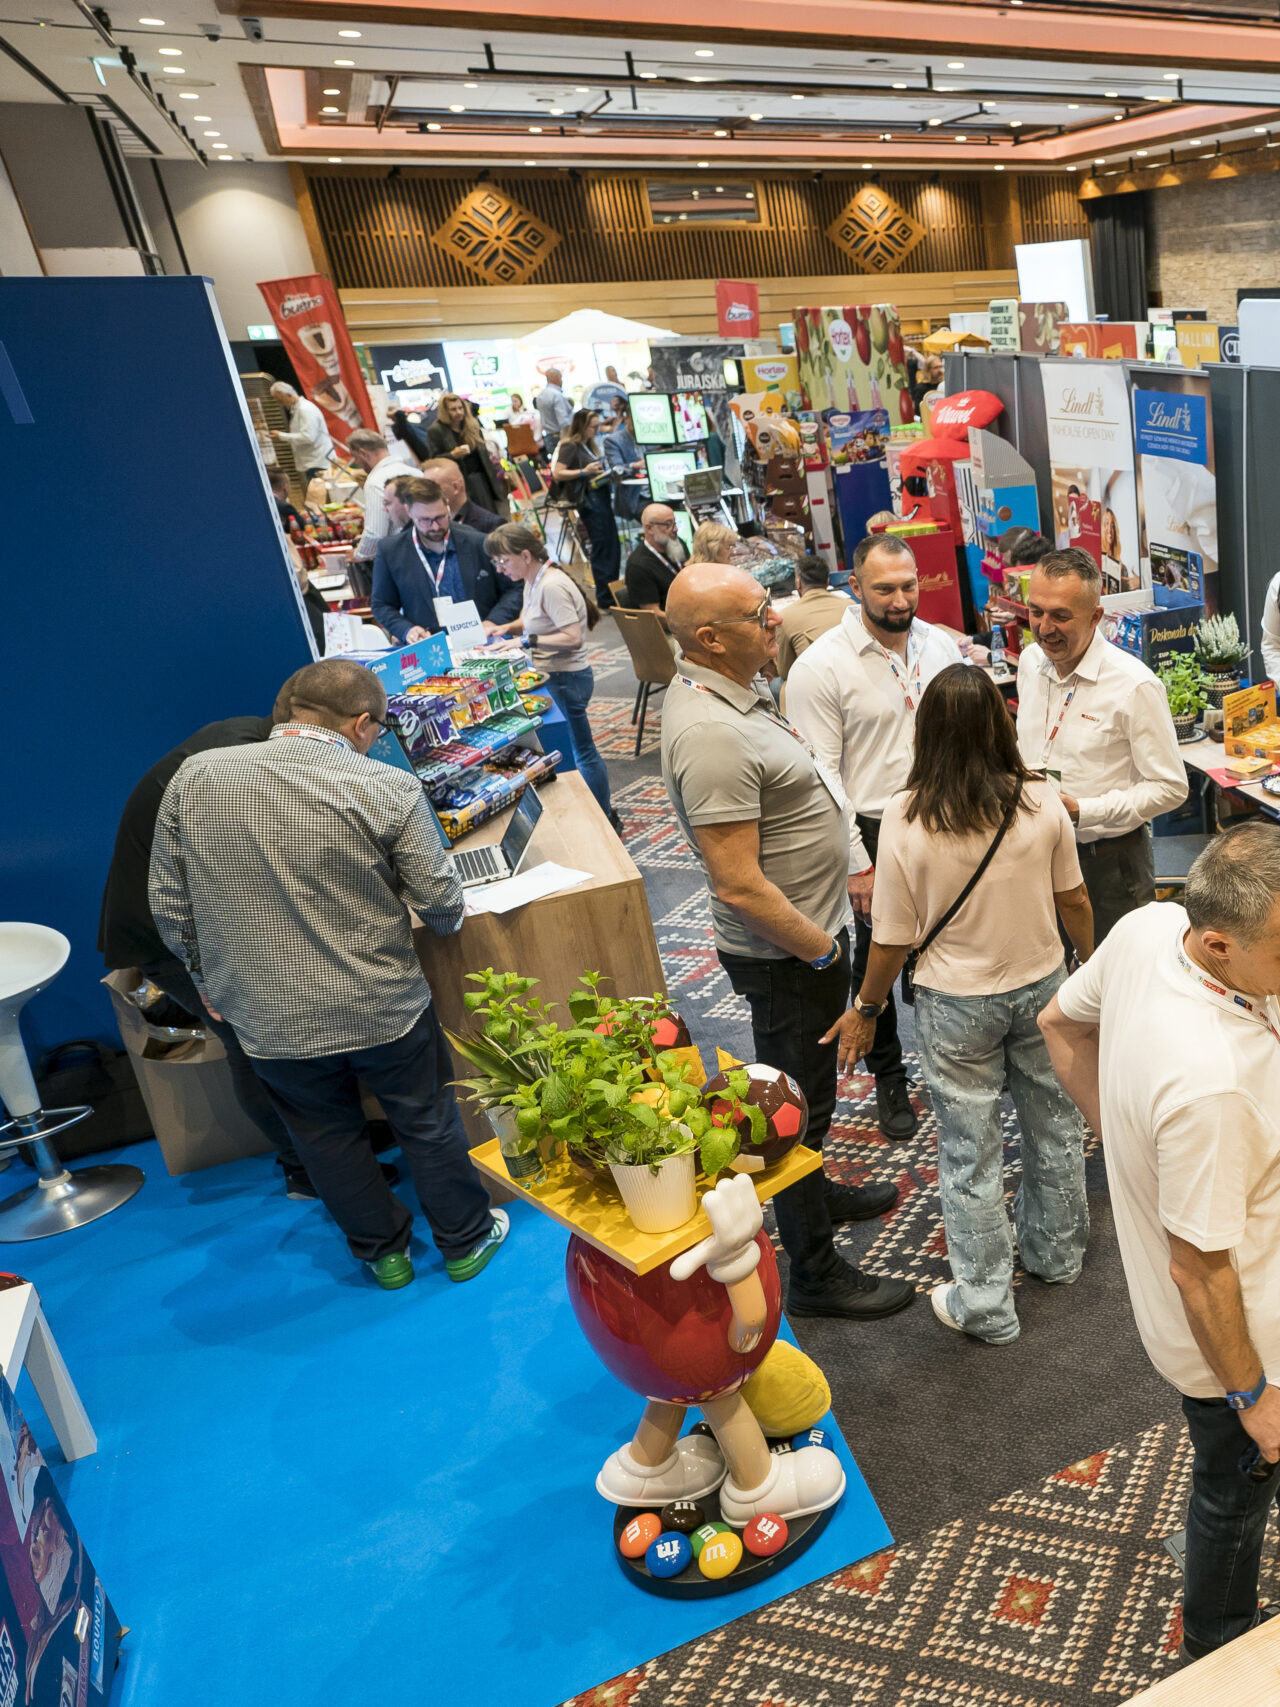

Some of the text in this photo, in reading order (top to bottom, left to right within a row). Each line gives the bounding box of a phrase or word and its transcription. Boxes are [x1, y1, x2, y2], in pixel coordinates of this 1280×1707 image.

[1179, 332, 1215, 348] PALLINI
[757, 366, 786, 375] Hortex
[676, 374, 727, 389] JURAJSKA
[1059, 387, 1095, 415] Lindt
[1146, 401, 1182, 430] Lindt
[450, 620, 479, 632] EKSPOZYCJA
[1151, 625, 1187, 643] Doskonała
[757, 1516, 780, 1538] m
[93, 1594, 102, 1663] BOUNTY
